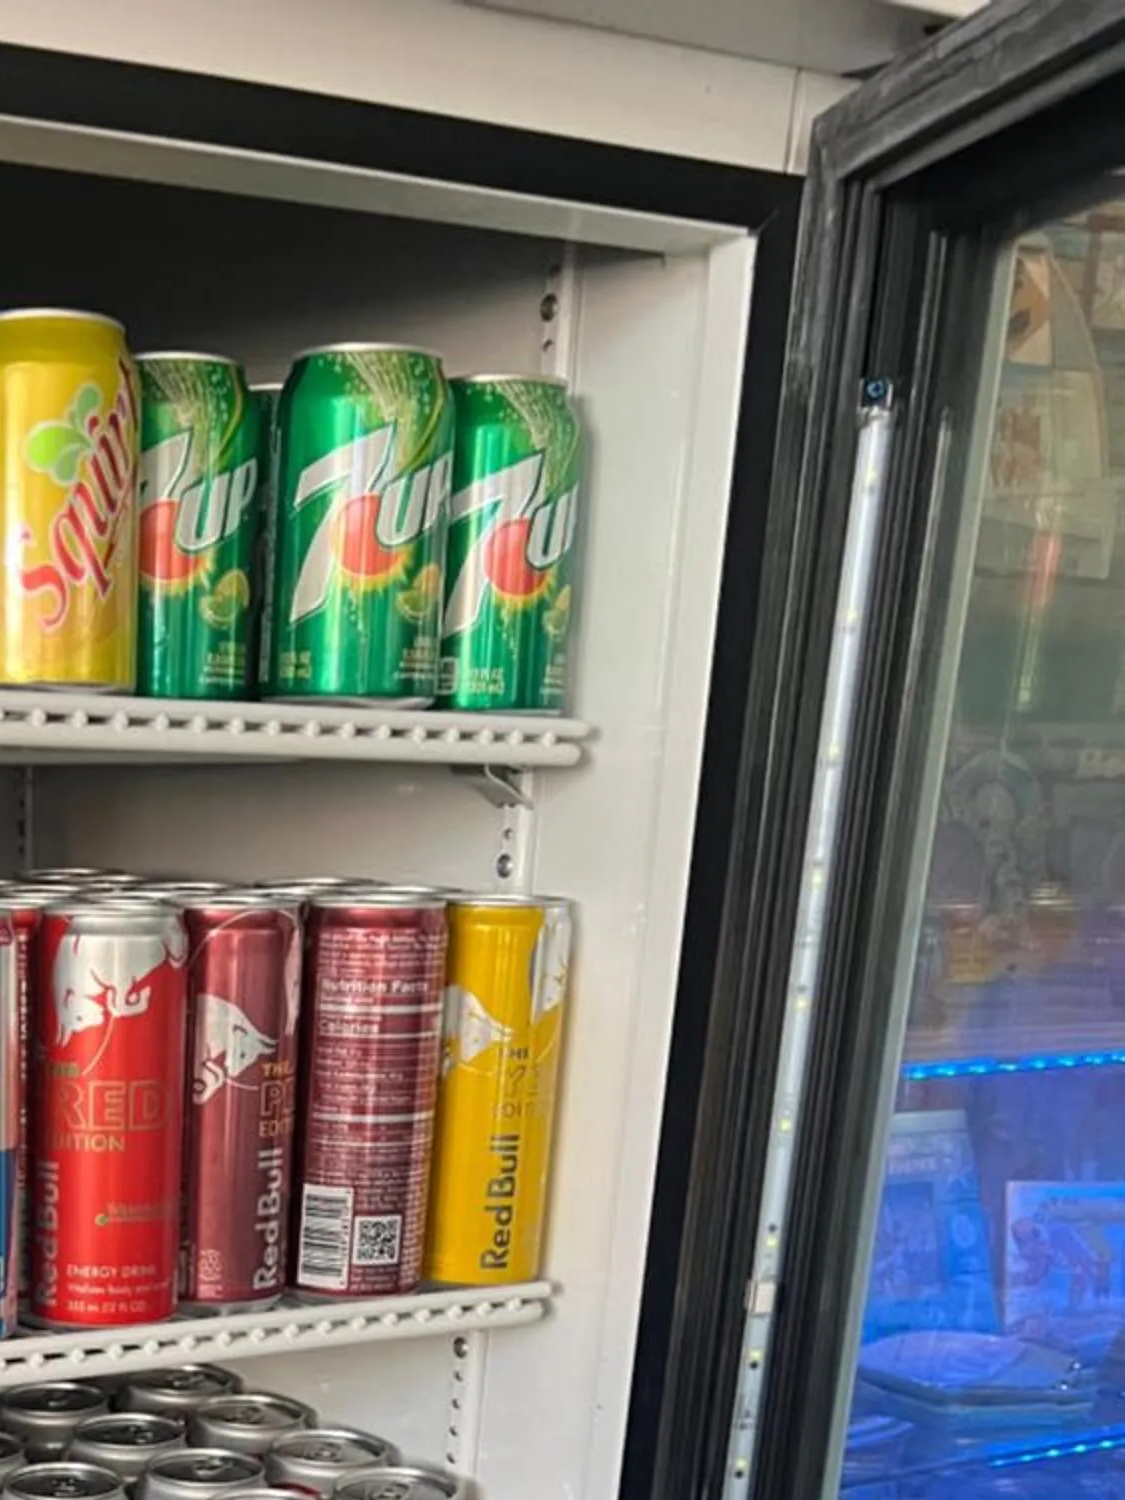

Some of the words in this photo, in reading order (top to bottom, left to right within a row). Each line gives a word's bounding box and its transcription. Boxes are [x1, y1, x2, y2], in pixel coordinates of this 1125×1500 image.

[320, 978, 388, 994] Nutrition
[391, 980, 429, 995] Facts
[53, 1080, 171, 1132] RED
[257, 1146, 284, 1214] Bull
[487, 1133, 519, 1199] Bull
[252, 1225, 283, 1291] Red
[480, 1205, 514, 1270] Red
